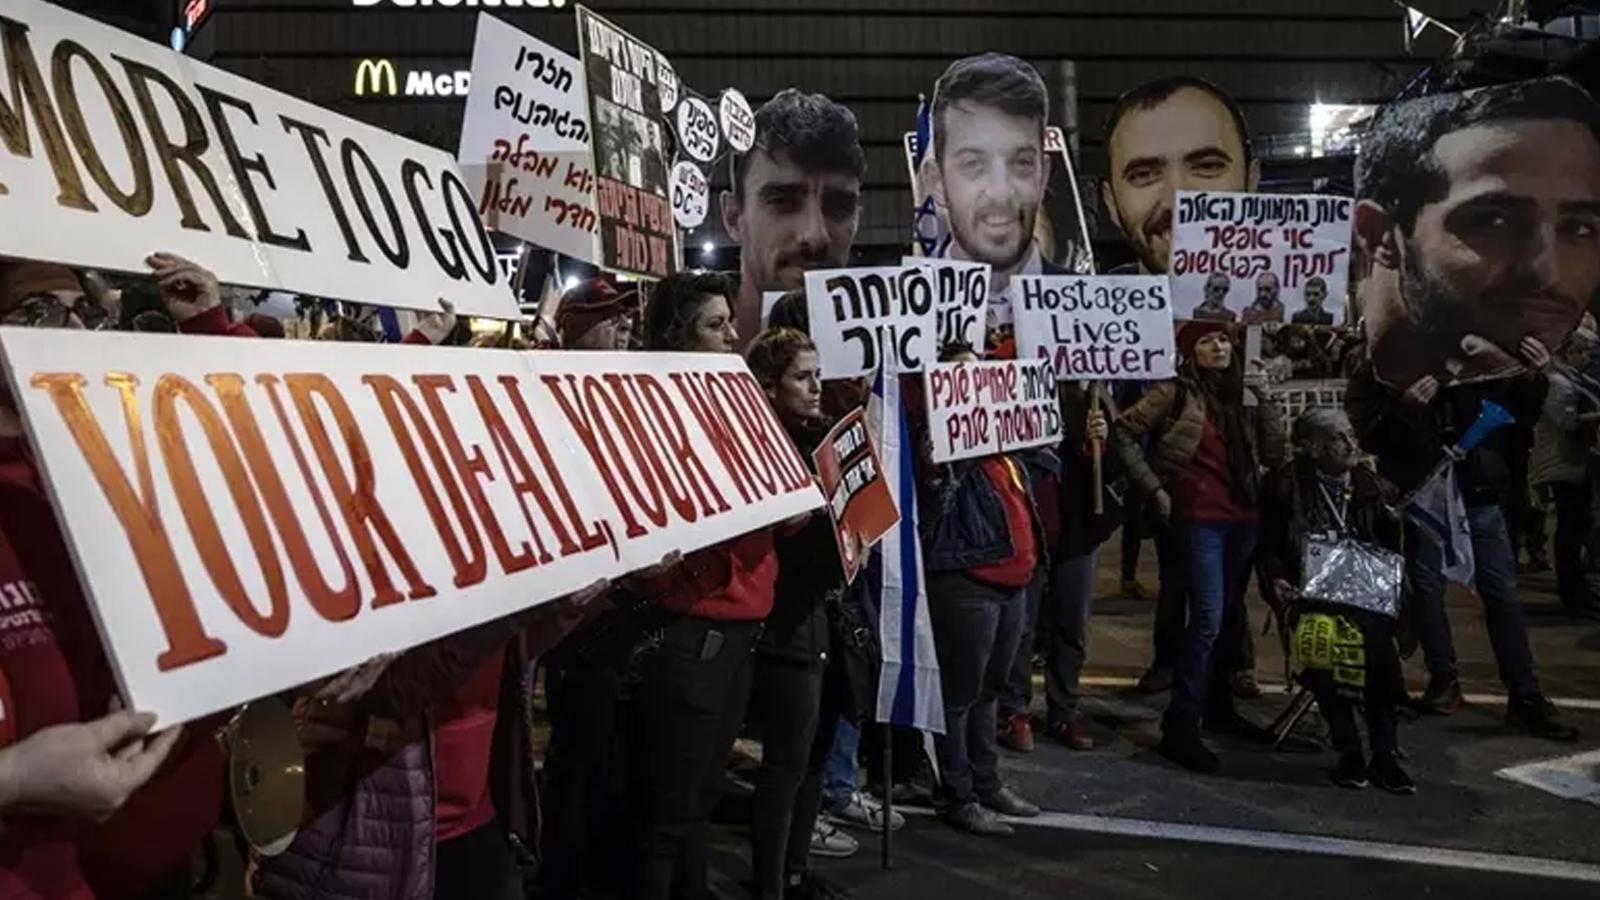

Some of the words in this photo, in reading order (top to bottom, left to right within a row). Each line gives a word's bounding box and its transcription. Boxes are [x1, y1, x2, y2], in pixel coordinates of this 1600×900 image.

[494, 85, 590, 144] הגיהנום
[0, 15, 312, 253] MORE
[278, 113, 410, 270] TO
[401, 158, 498, 286] GO
[544, 195, 598, 235] חדרי
[1178, 193, 1235, 224] האלה
[934, 265, 987, 309] סליח
[1282, 247, 1347, 288] לתקן
[825, 266, 932, 322] סליחה
[1022, 278, 1167, 316] Hostages
[1051, 314, 1141, 344] Lives
[1037, 345, 1166, 376] Matter
[29, 371, 438, 672] YOUR
[361, 373, 620, 588] DEAL,
[540, 372, 732, 540] YOUR
[668, 371, 812, 505] WORD
